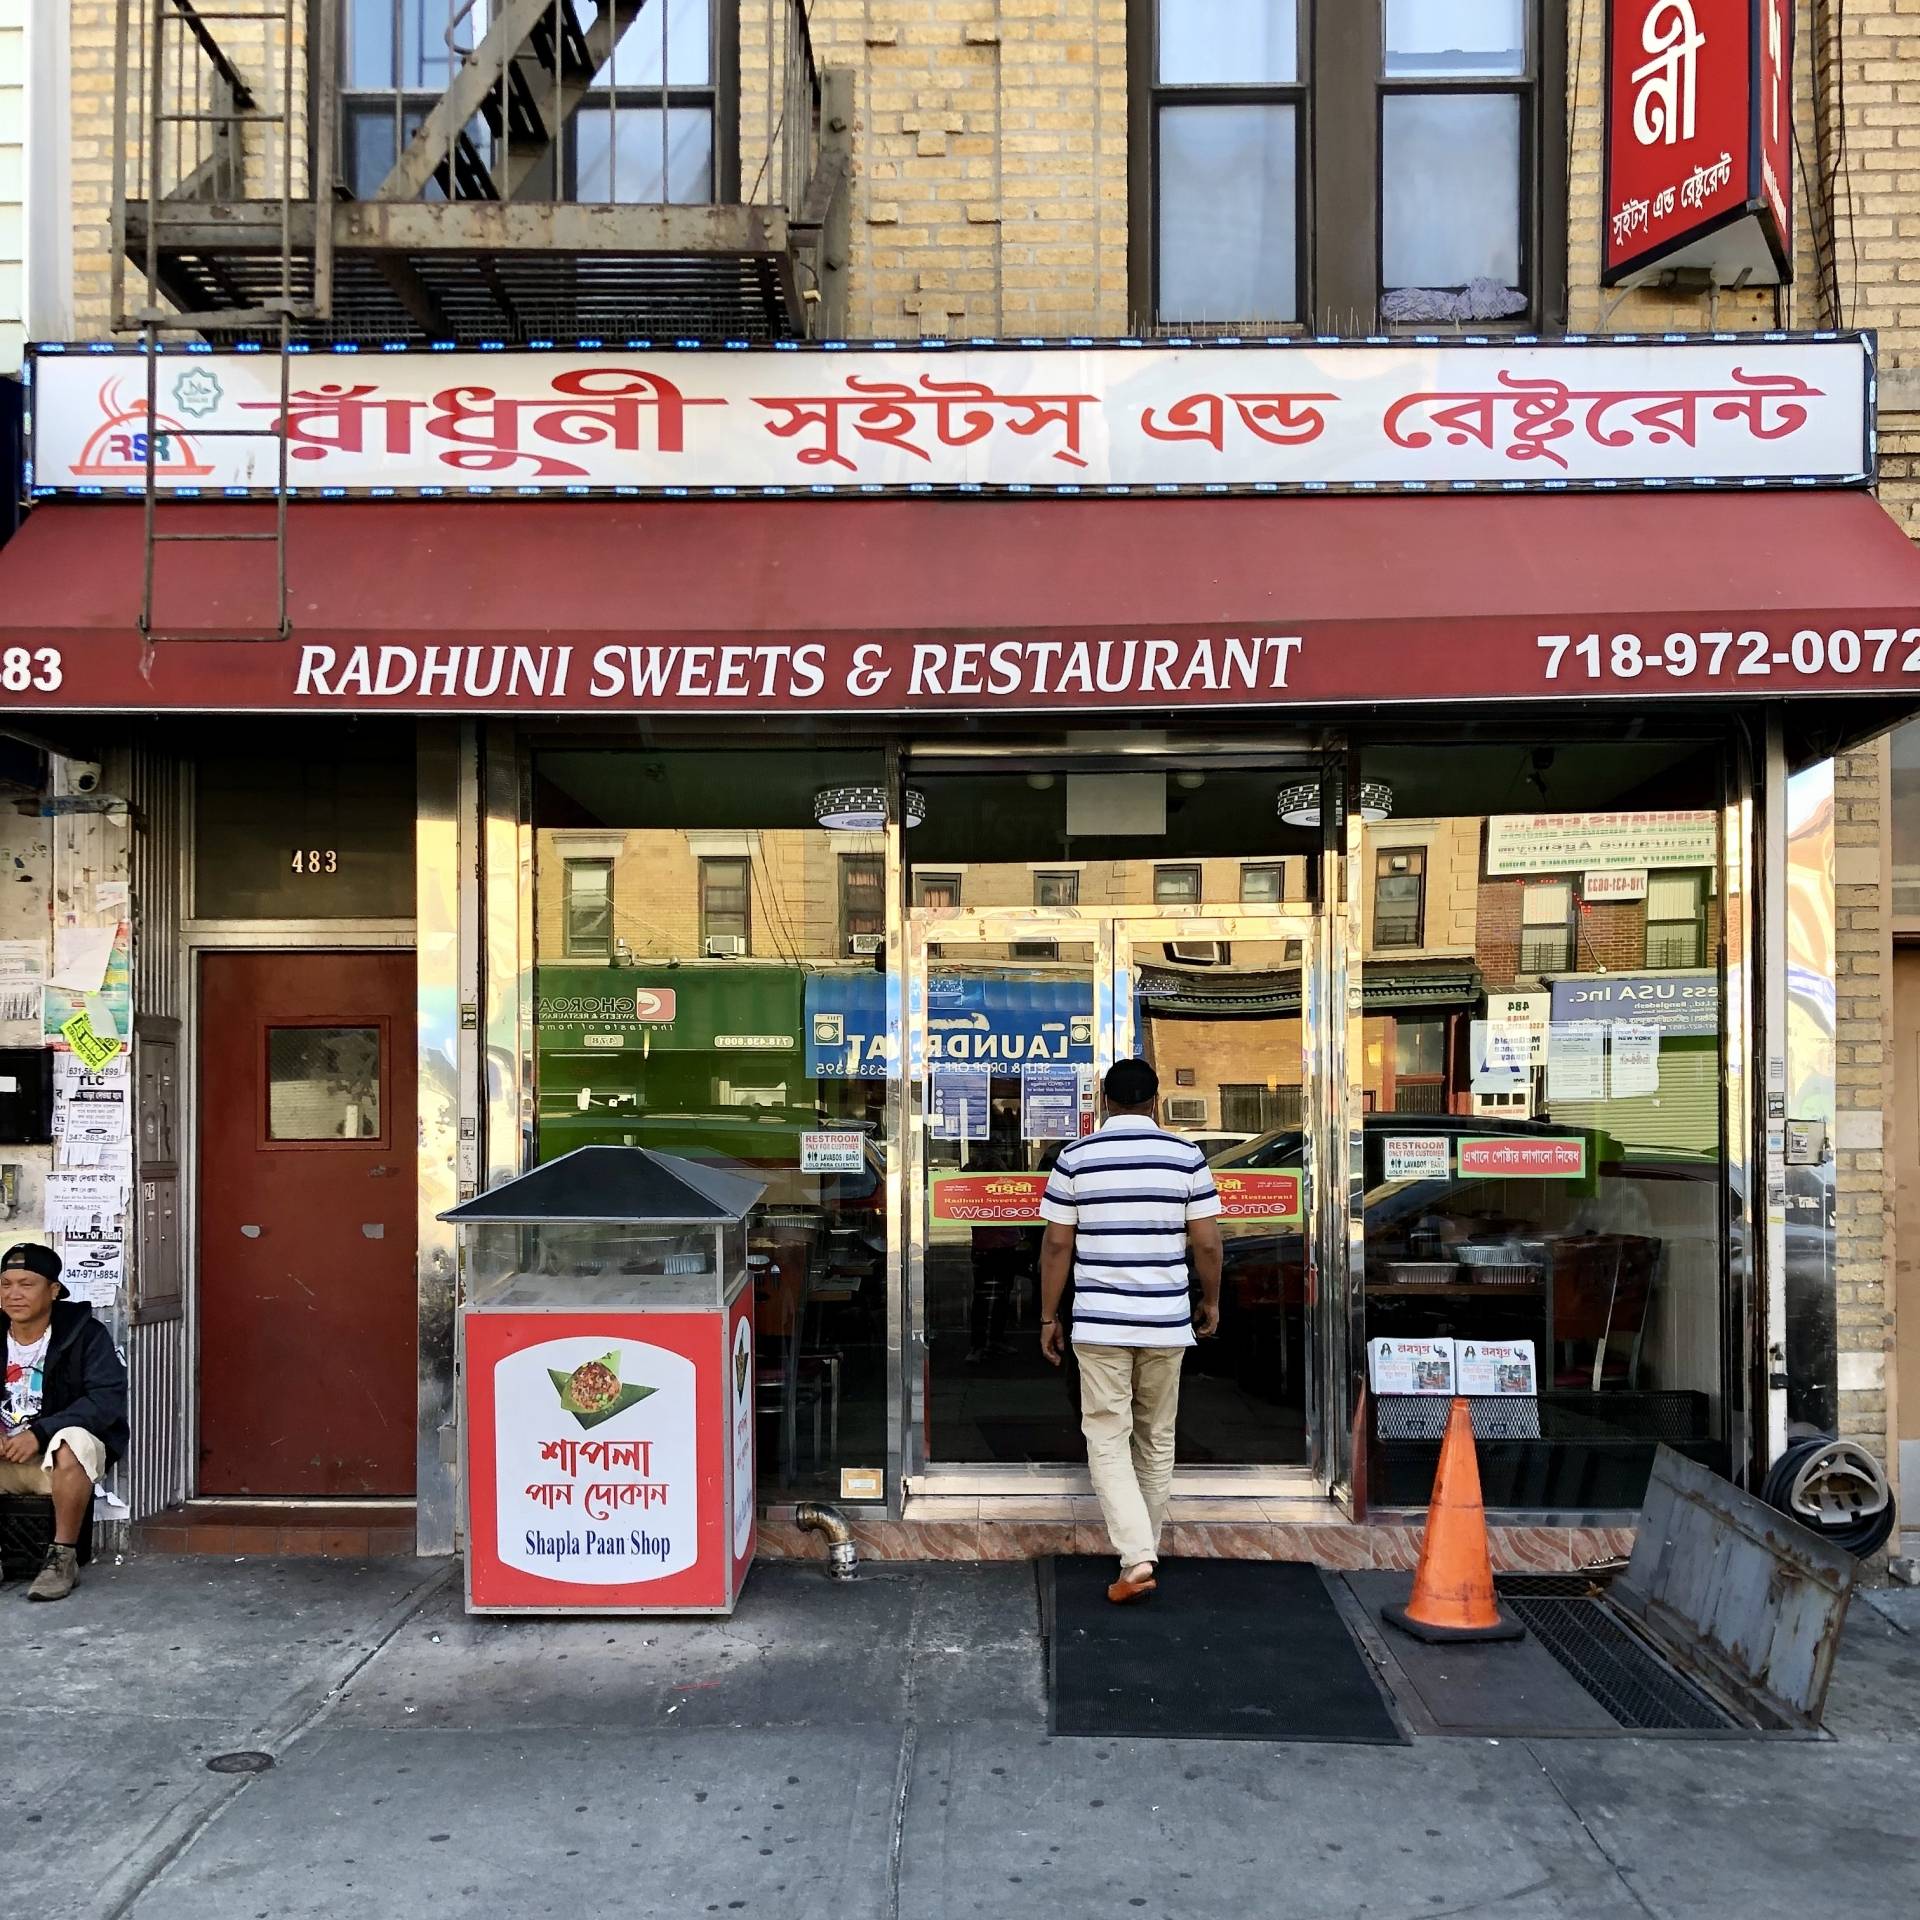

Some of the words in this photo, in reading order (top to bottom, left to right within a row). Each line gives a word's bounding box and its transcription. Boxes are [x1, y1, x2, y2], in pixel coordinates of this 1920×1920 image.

[1653, 186, 1676, 219] এন্ড
[749, 373, 1102, 471] সুইটস্
[1140, 392, 1341, 453] এন্ড
[1383, 366, 1827, 470] রেষ্টুরেন্ট
[110, 433, 171, 461] RSR
[294, 645, 573, 698] RADHUNI
[589, 644, 826, 698] SWEETS
[845, 642, 893, 697] &
[906, 636, 1303, 695] RESTAURANT
[1537, 627, 1920, 680] 718-972-0072
[0, 647, 62, 691] 83
[291, 850, 337, 873] 483
[79, 1075, 105, 1086] TLC
[805, 1135, 859, 1143] RESTROOM
[1388, 1142, 1444, 1150] RESTROOM
[1463, 1150, 1489, 1163] এখানে
[1521, 1149, 1553, 1163] লাগানো
[1555, 1146, 1579, 1163] নিষেধ
[950, 1206, 1040, 1219] Welco
[66, 1269, 119, 1279] 347-971-8854
[537, 1439, 653, 1478] শাপলা
[525, 1483, 574, 1510] পান
[584, 1483, 670, 1521] দোকান
[525, 1530, 580, 1562] Shapla
[585, 1531, 626, 1556] Paan
[630, 1530, 671, 1562] Shop
